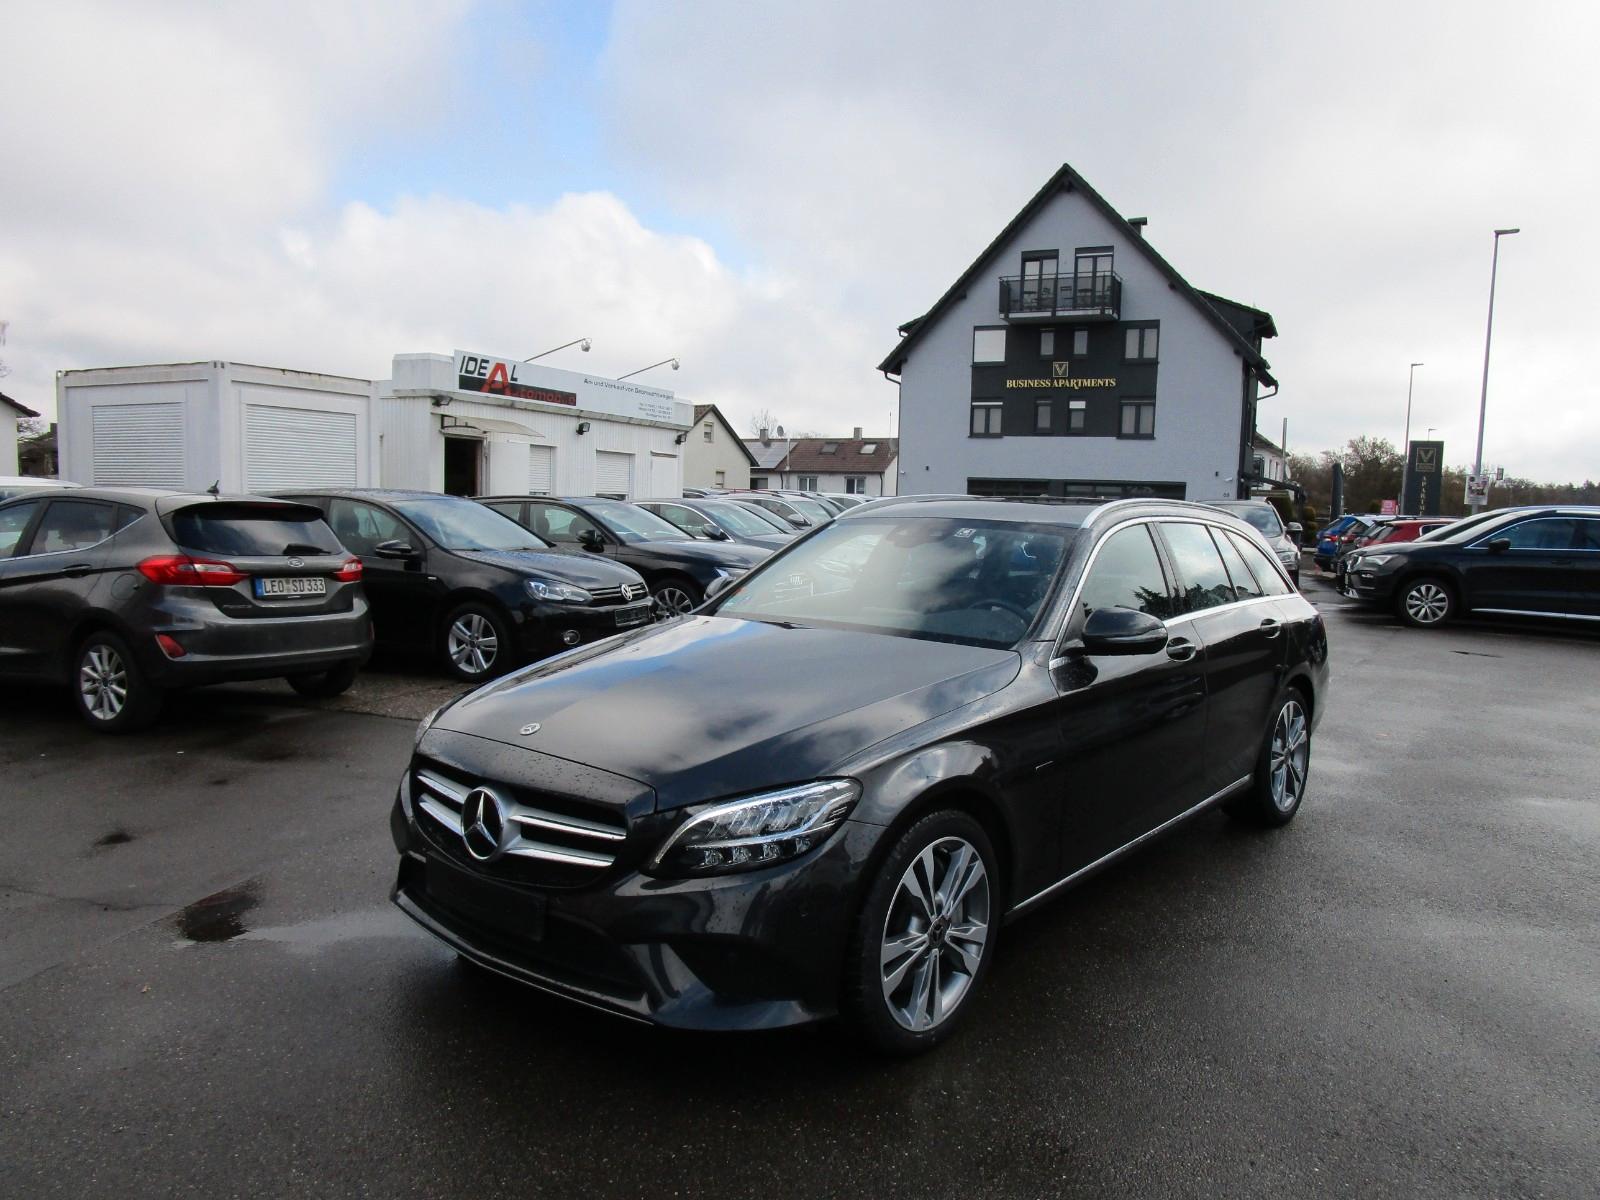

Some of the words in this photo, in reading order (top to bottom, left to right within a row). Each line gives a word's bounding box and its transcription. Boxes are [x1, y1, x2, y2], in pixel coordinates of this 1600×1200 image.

[459, 355, 518, 396] IDEAL
[1006, 379, 1051, 388] BUSINESS
[1052, 378, 1116, 389] APARTMENTS
[264, 580, 284, 593] LEO
[291, 579, 305, 593] SD
[306, 579, 324, 592] 333
